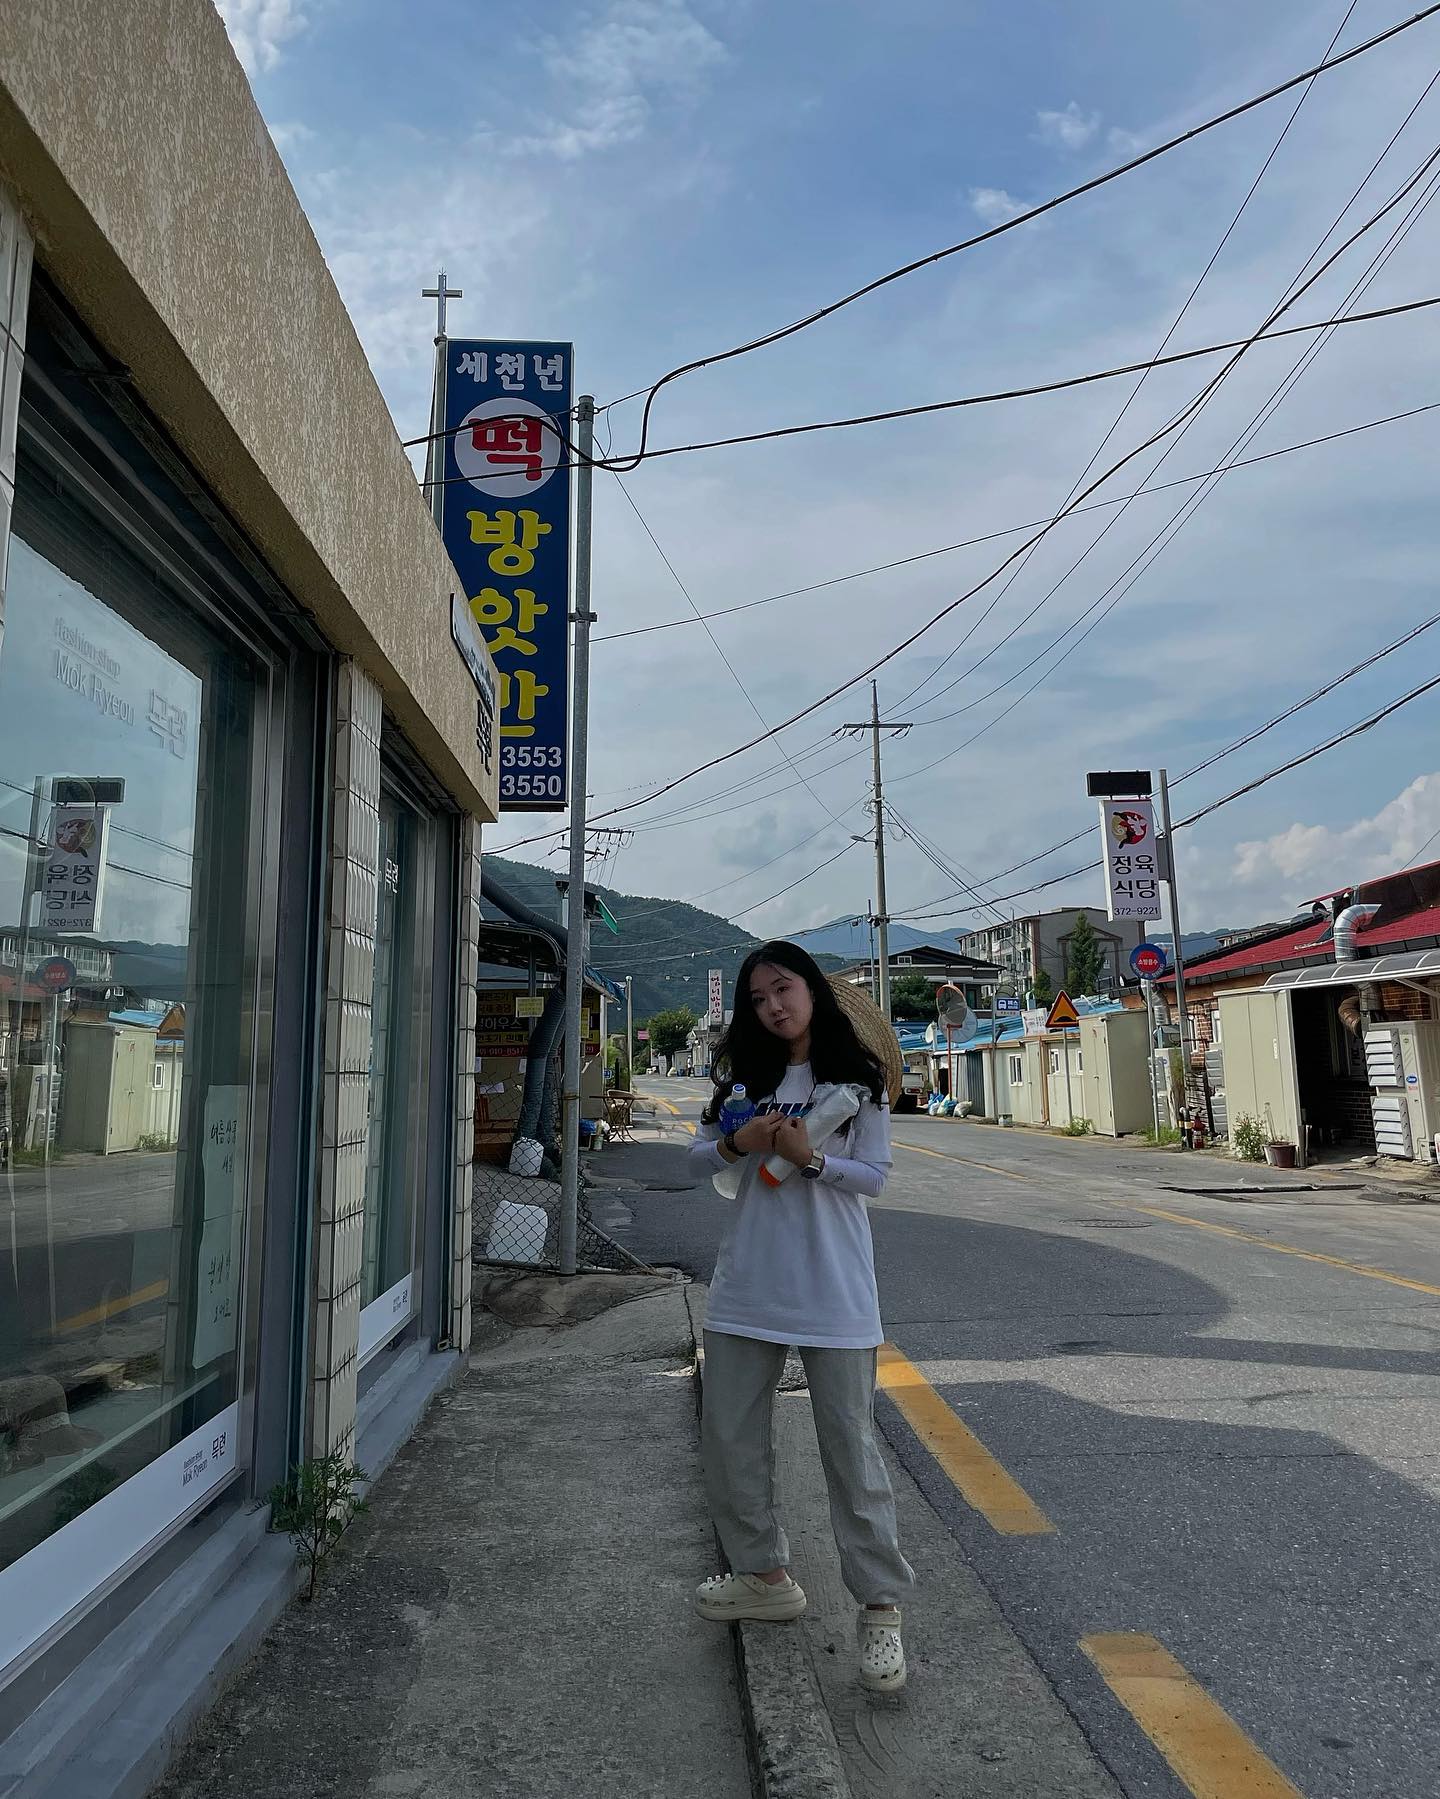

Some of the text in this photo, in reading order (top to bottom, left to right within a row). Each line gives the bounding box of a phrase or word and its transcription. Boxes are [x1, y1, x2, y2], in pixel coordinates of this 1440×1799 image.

[456, 352, 564, 391] 세천년
[468, 417, 542, 480] 떡
[501, 746, 562, 768] 3553
[501, 775, 562, 796] 3550
[1112, 854, 1154, 875] 정육
[1113, 880, 1158, 899] 식당
[1114, 906, 1159, 917] 372-9221
[211, 1431, 226, 1460] 목련
